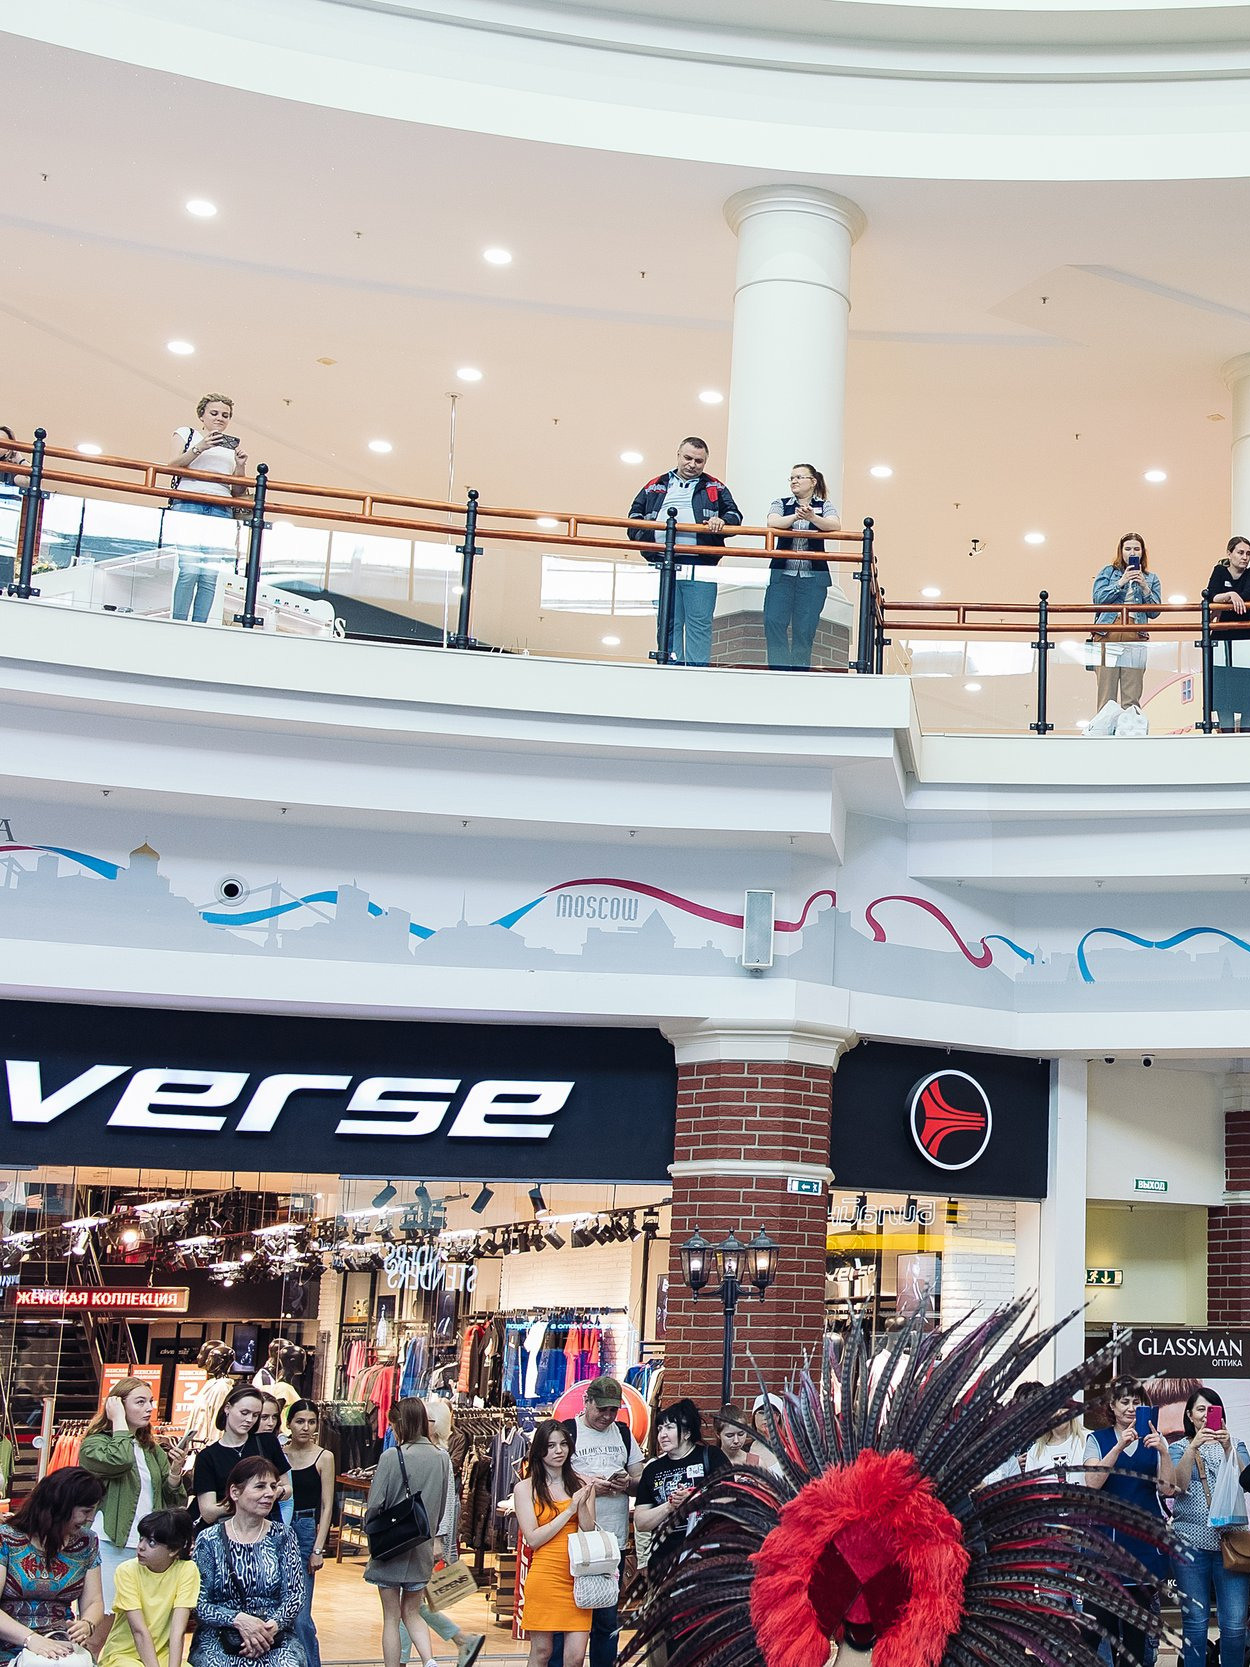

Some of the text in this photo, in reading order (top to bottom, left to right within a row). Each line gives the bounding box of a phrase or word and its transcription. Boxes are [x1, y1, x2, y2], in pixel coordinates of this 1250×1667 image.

[556, 893, 639, 921] MOSCOW
[1138, 1180, 1165, 1191] ВЫХОД
[16, 1291, 178, 1307] ЖЕНСКАЯ КОЛЛЕКЦИЯ
[1138, 1337, 1243, 1357] GLASSMAN
[1211, 1358, 1243, 1368] ОПТИКА
